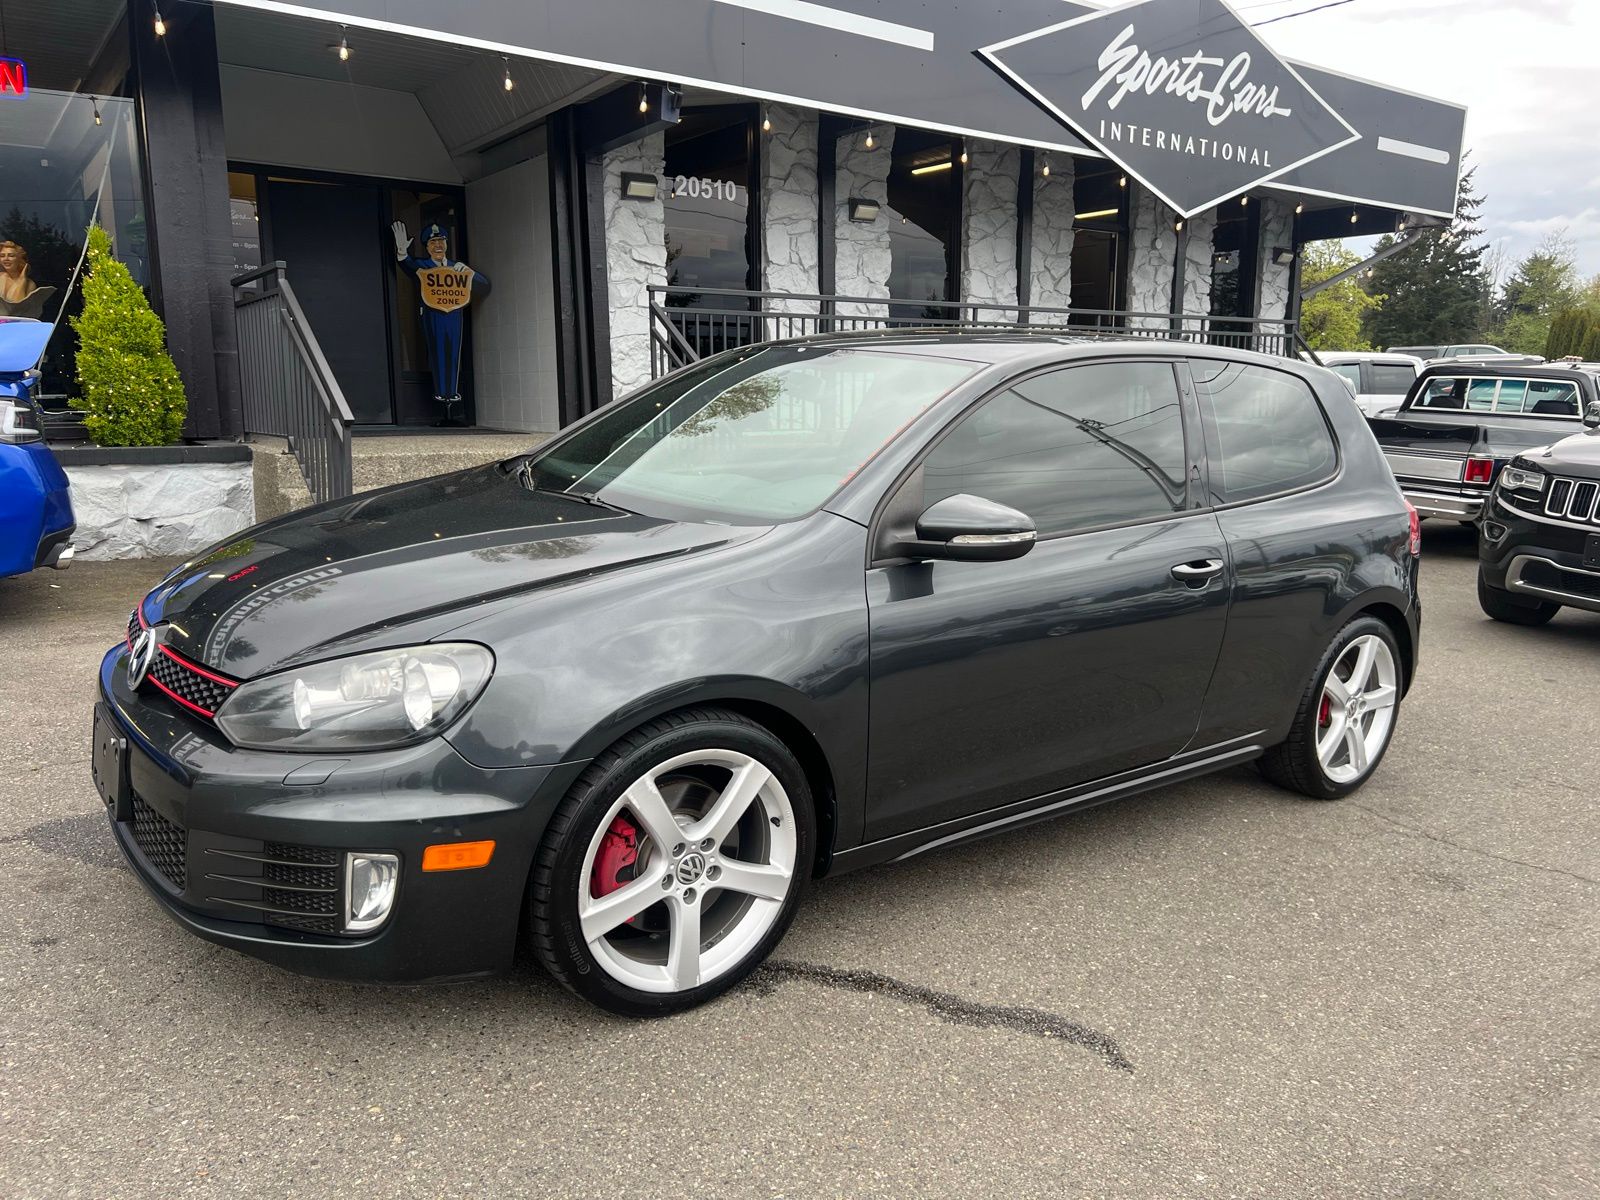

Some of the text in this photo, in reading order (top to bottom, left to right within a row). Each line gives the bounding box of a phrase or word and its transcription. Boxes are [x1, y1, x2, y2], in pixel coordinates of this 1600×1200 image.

[1081, 23, 1292, 126] Sports Cars
[1100, 119, 1271, 167] INTERNATIONAL
[675, 174, 737, 202] 20510
[427, 273, 468, 288] SLOW
[430, 288, 466, 297] SCHOOL
[436, 297, 460, 305] ZONE
[676, 852, 706, 885] VW
